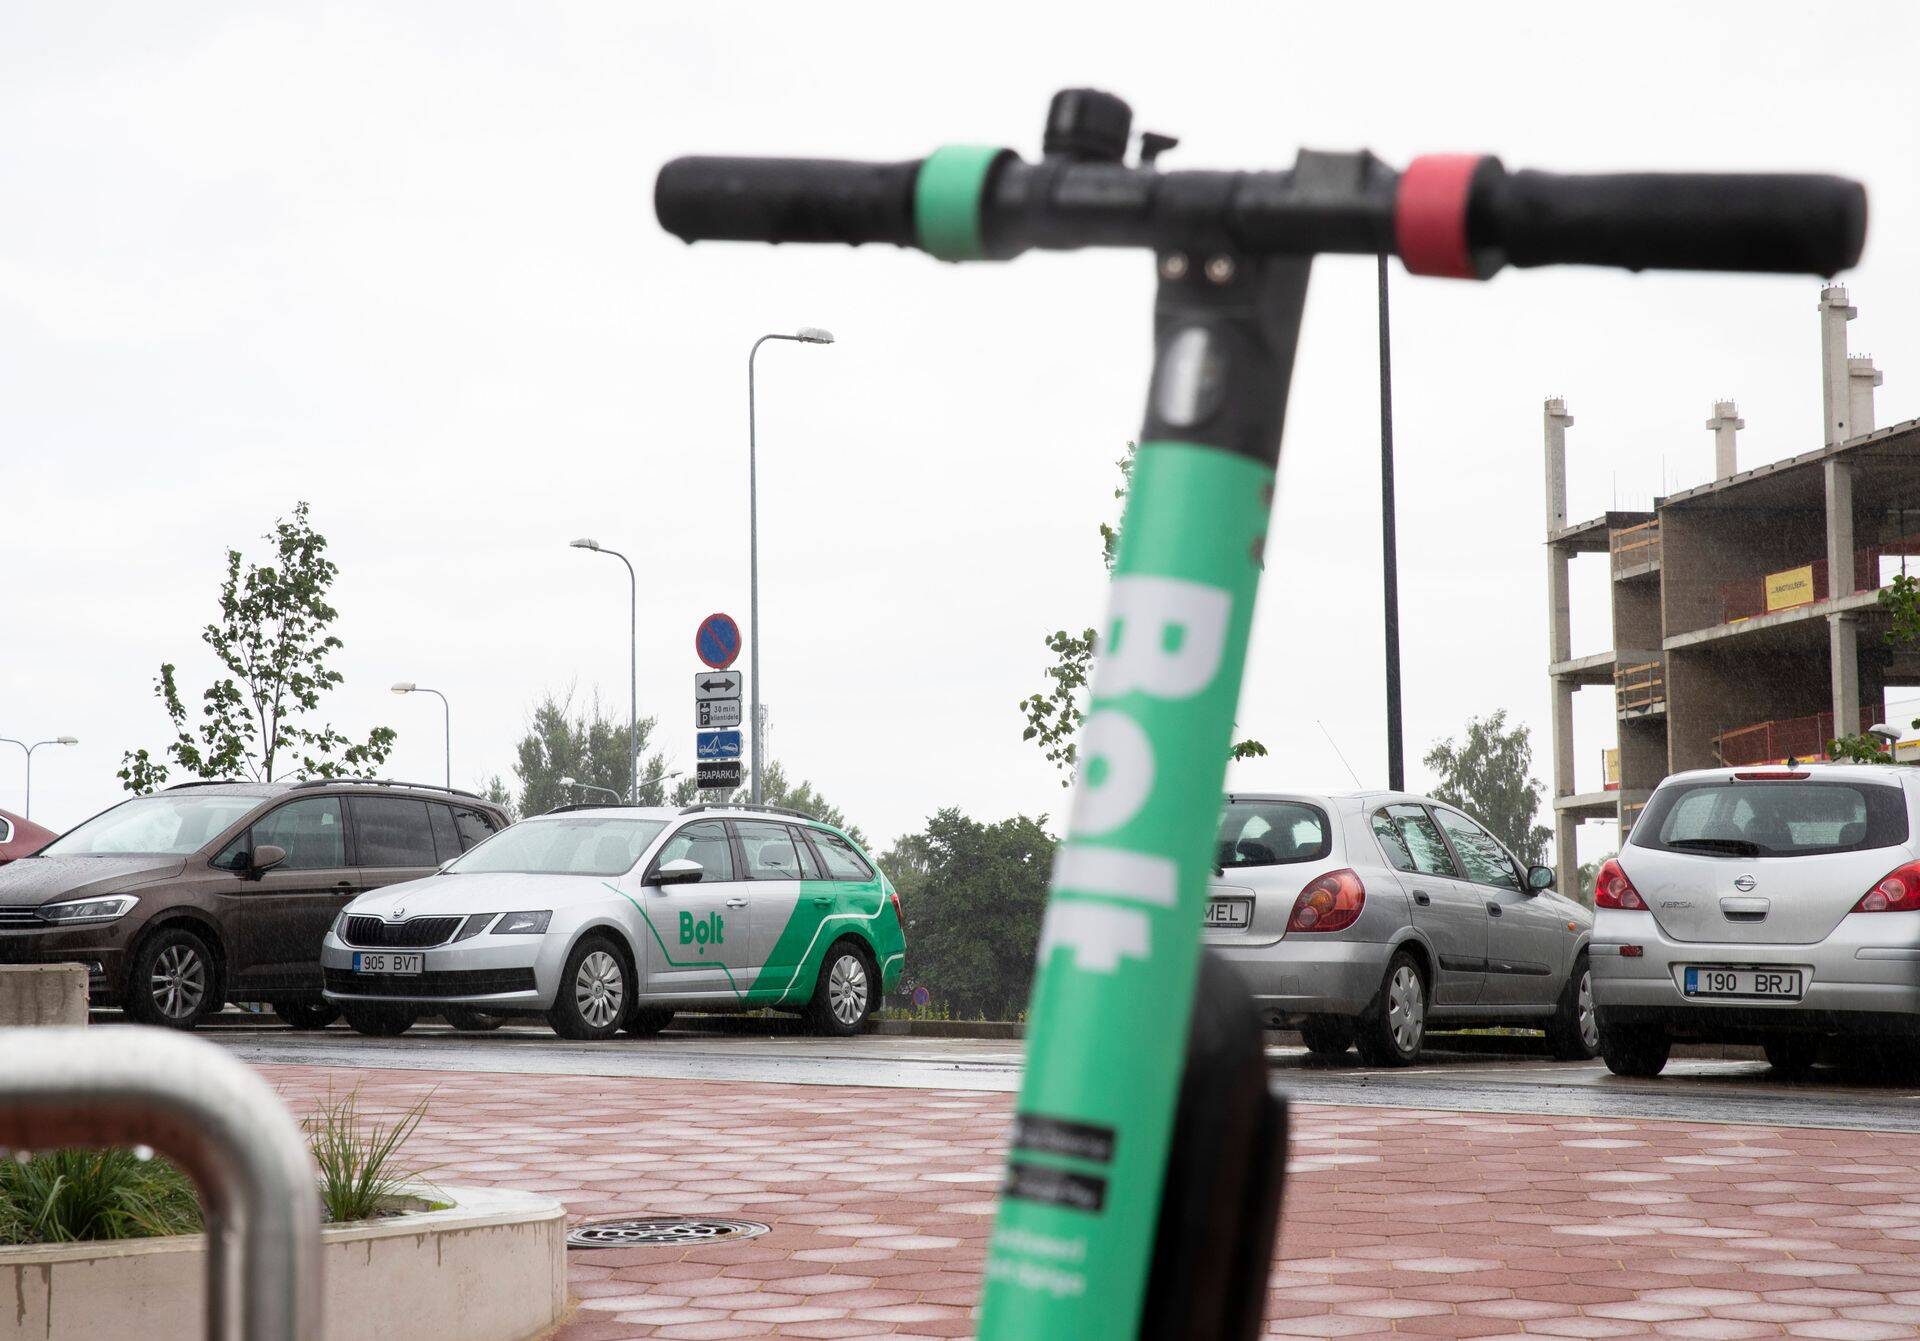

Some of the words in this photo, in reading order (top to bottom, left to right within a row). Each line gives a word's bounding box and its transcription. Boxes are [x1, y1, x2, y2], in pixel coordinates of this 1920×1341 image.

[697, 769, 740, 780] ERAPARKLA
[679, 911, 724, 954] Bolt
[364, 956, 385, 970] 905
[393, 956, 419, 971] BVT
[1706, 973, 1737, 991] 190
[1755, 974, 1793, 993] BRJ
